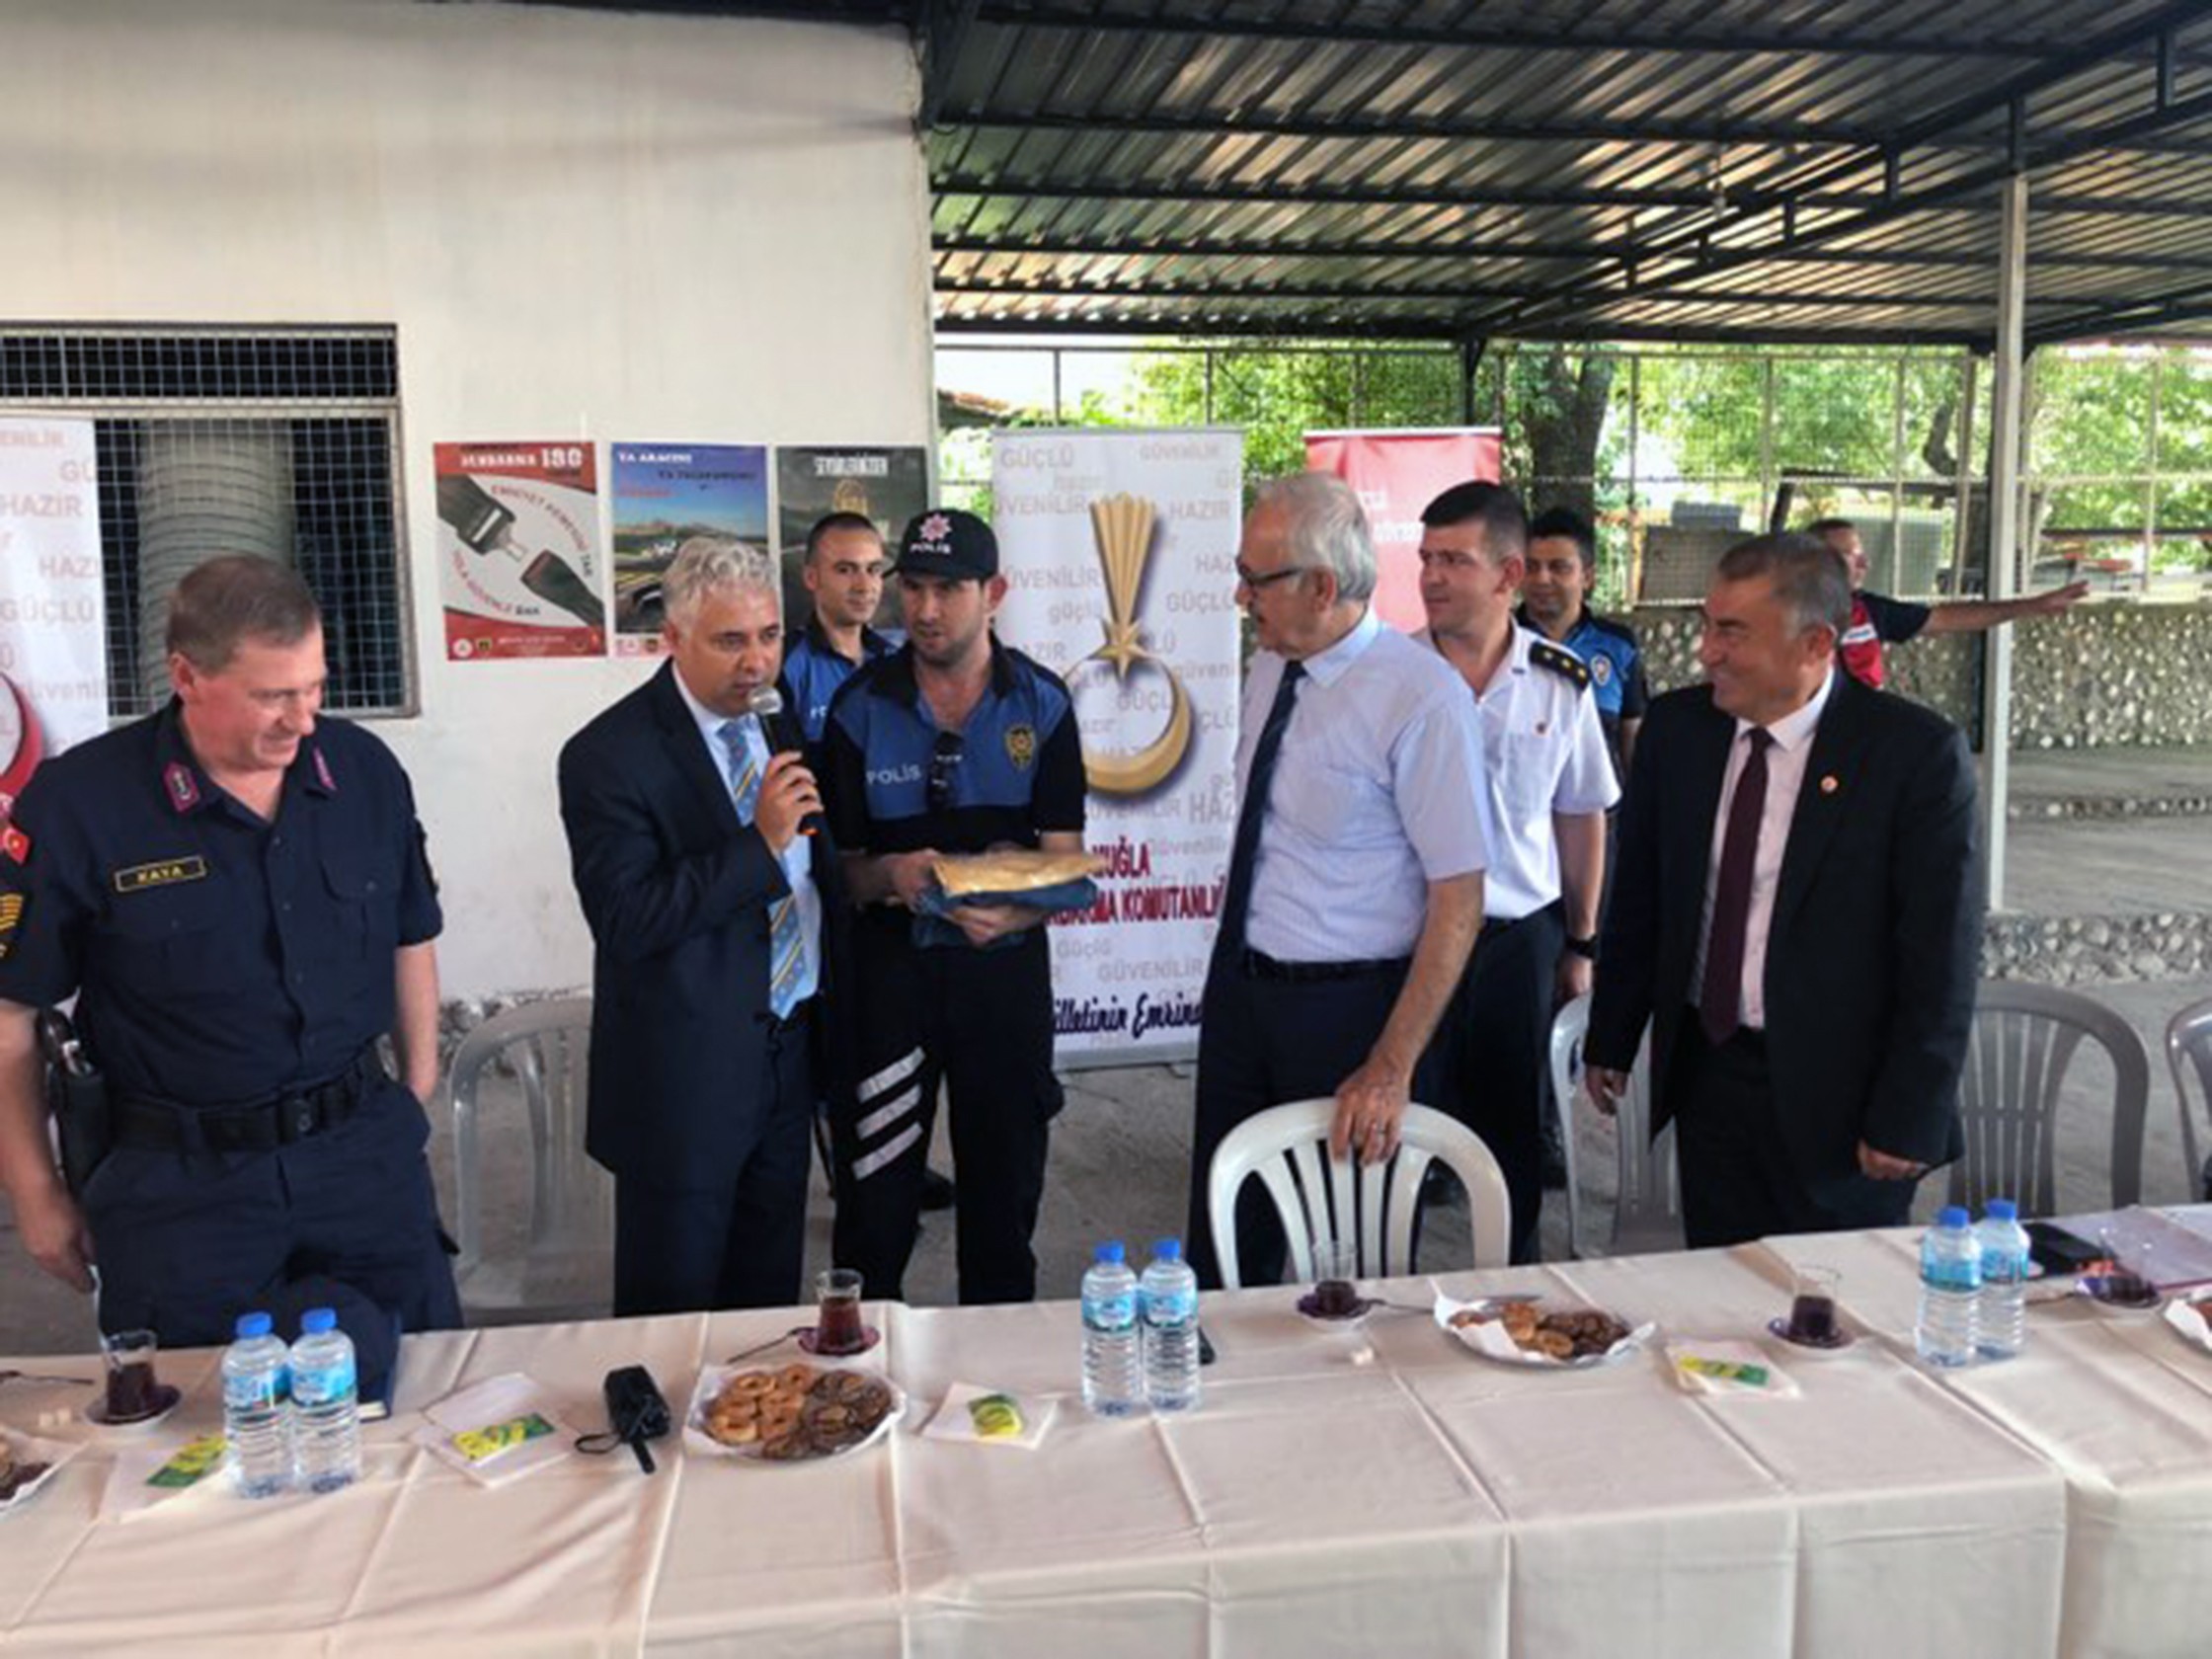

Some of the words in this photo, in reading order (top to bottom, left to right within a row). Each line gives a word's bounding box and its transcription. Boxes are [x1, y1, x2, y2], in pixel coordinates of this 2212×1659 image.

[1000, 442, 1073, 472] GÜÇLÜ
[866, 763, 921, 785] POLİS
[136, 865, 182, 885] KAYA
